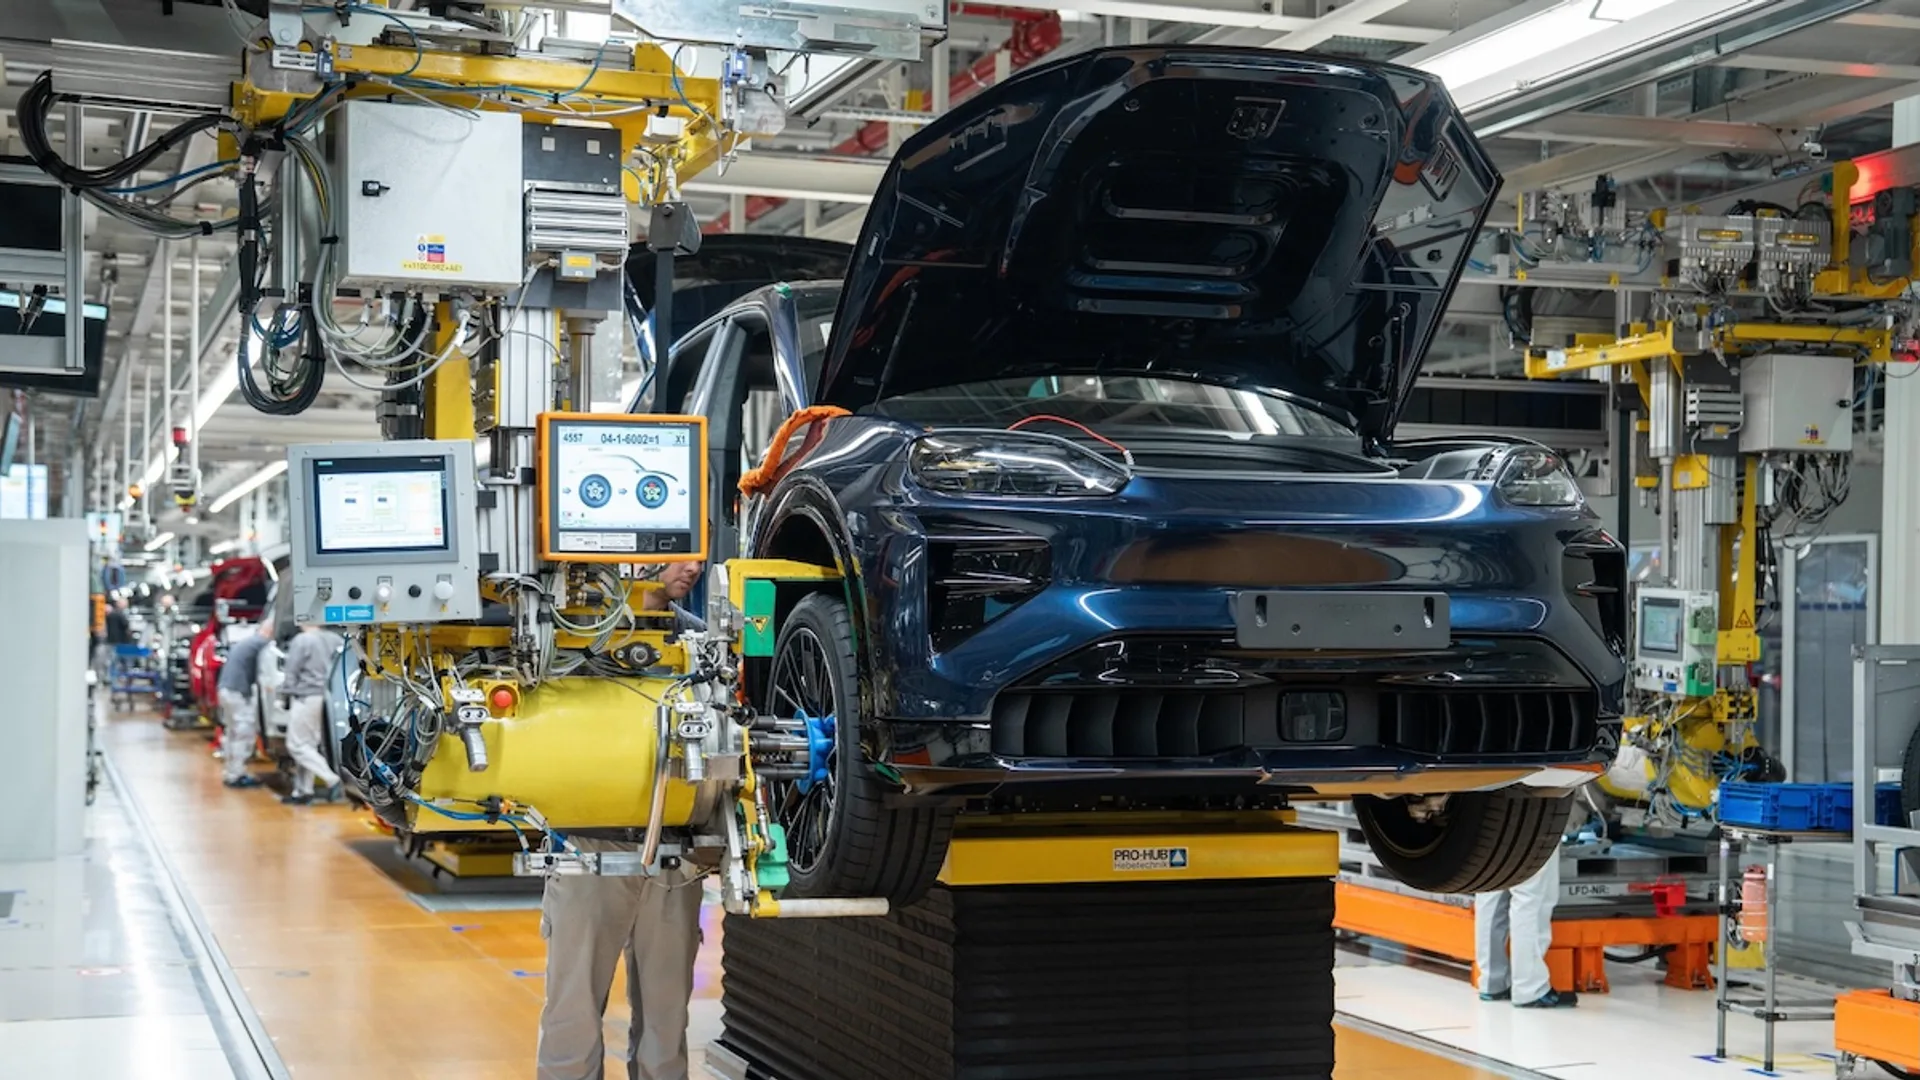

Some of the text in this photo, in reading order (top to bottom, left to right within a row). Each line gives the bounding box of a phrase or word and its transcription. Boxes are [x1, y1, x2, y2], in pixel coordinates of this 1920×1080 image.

[563, 432, 686, 444] 4557 04-1-6002=1 X1
[1114, 849, 1168, 861] PRO-HUB
[1114, 860, 1168, 870] Hebetechnik
